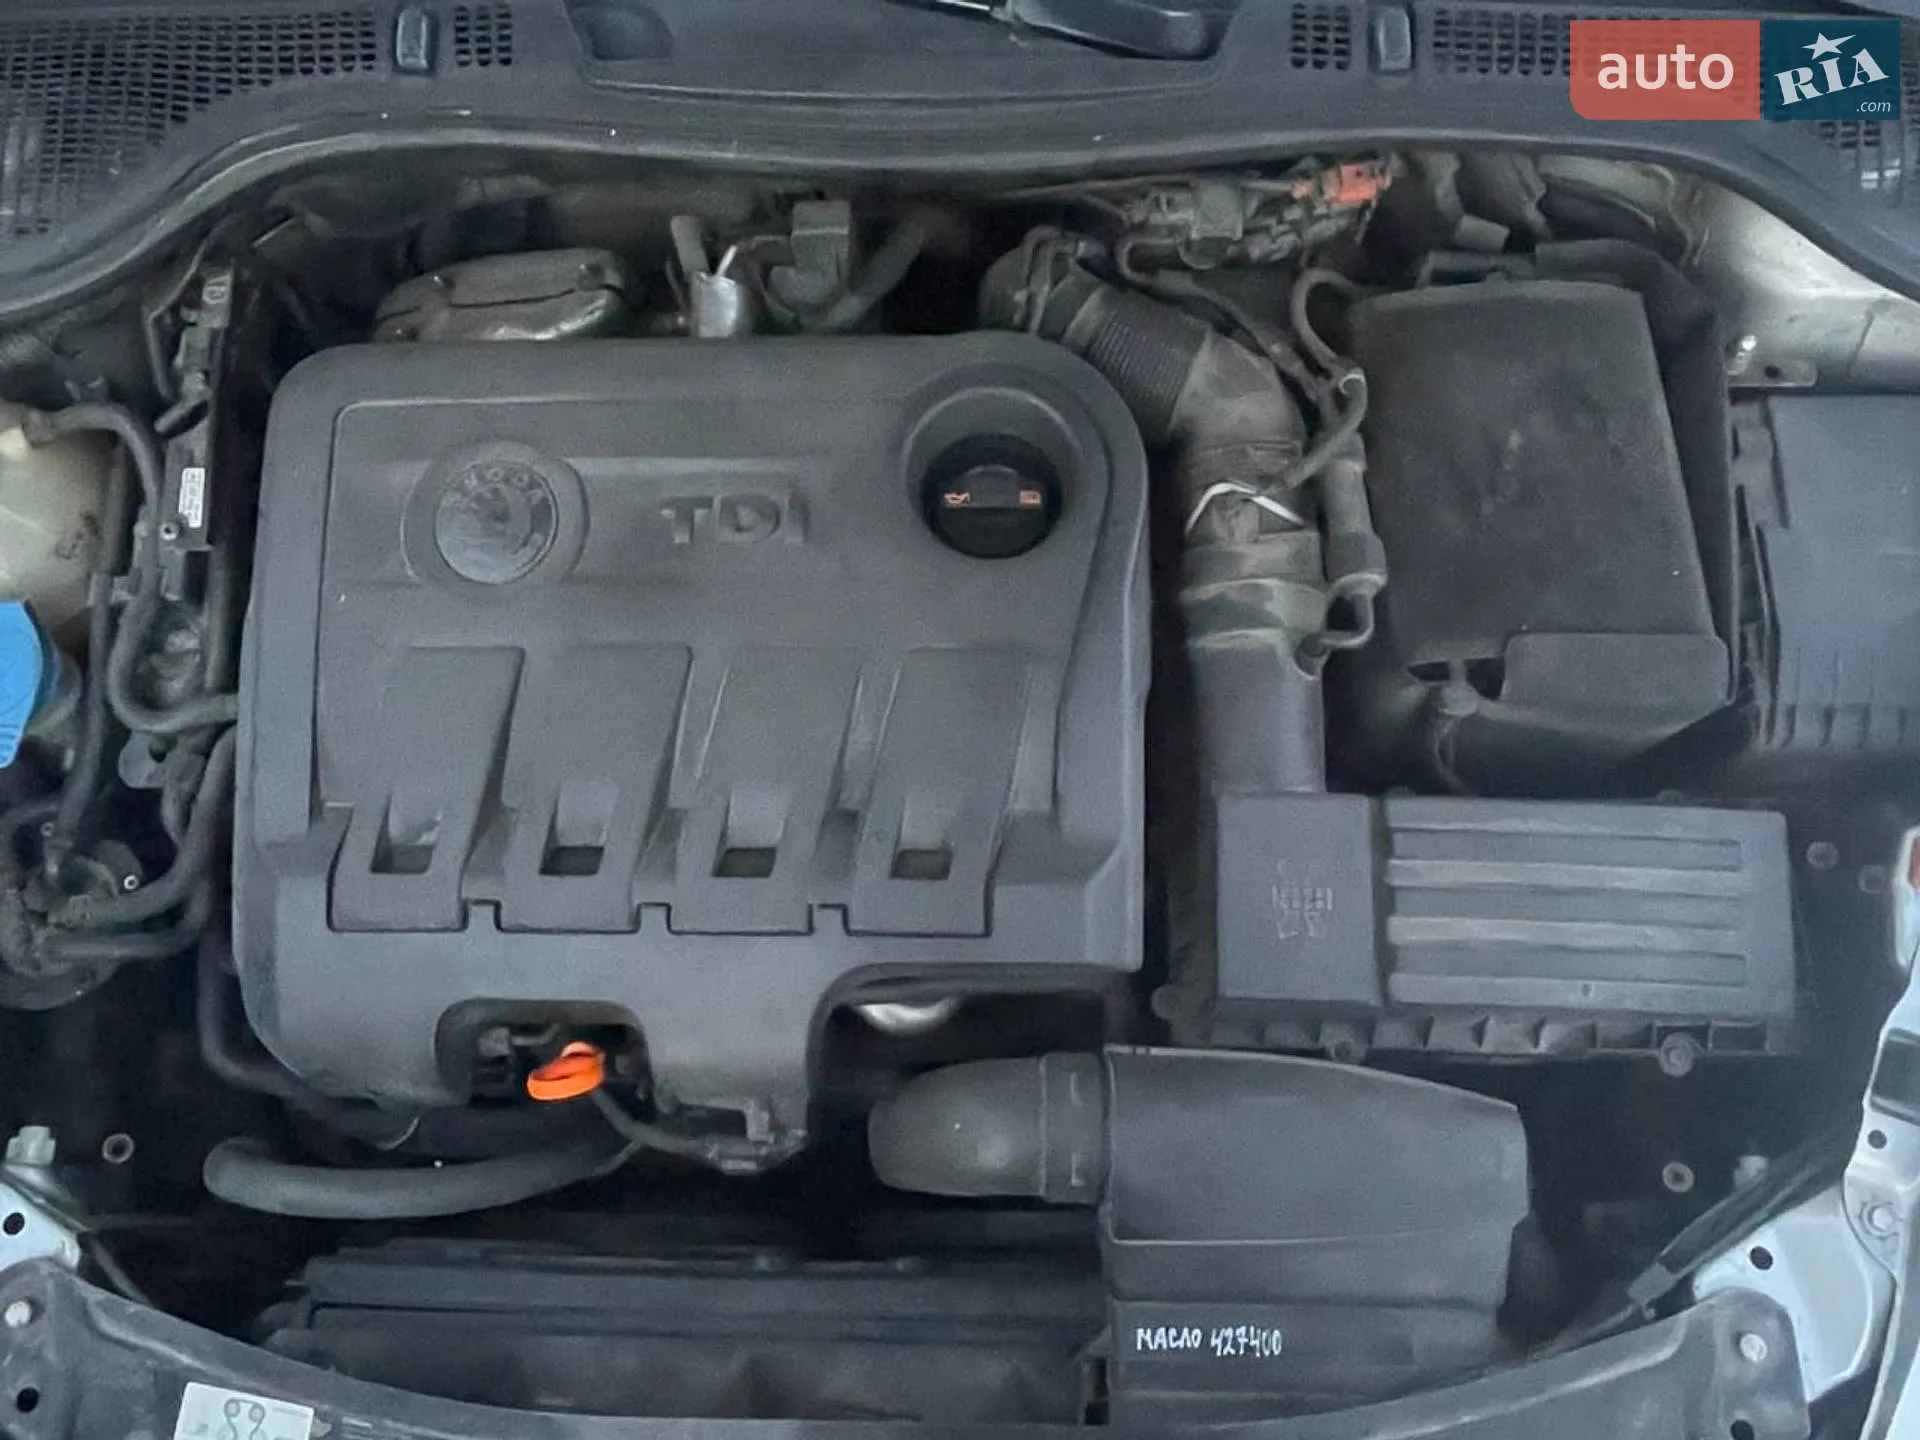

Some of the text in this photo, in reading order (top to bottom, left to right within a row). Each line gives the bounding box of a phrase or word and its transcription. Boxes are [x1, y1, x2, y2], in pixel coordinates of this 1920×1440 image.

[660, 491, 811, 545] TDI
[1136, 1325, 1283, 1357] МАСЛО 427400
